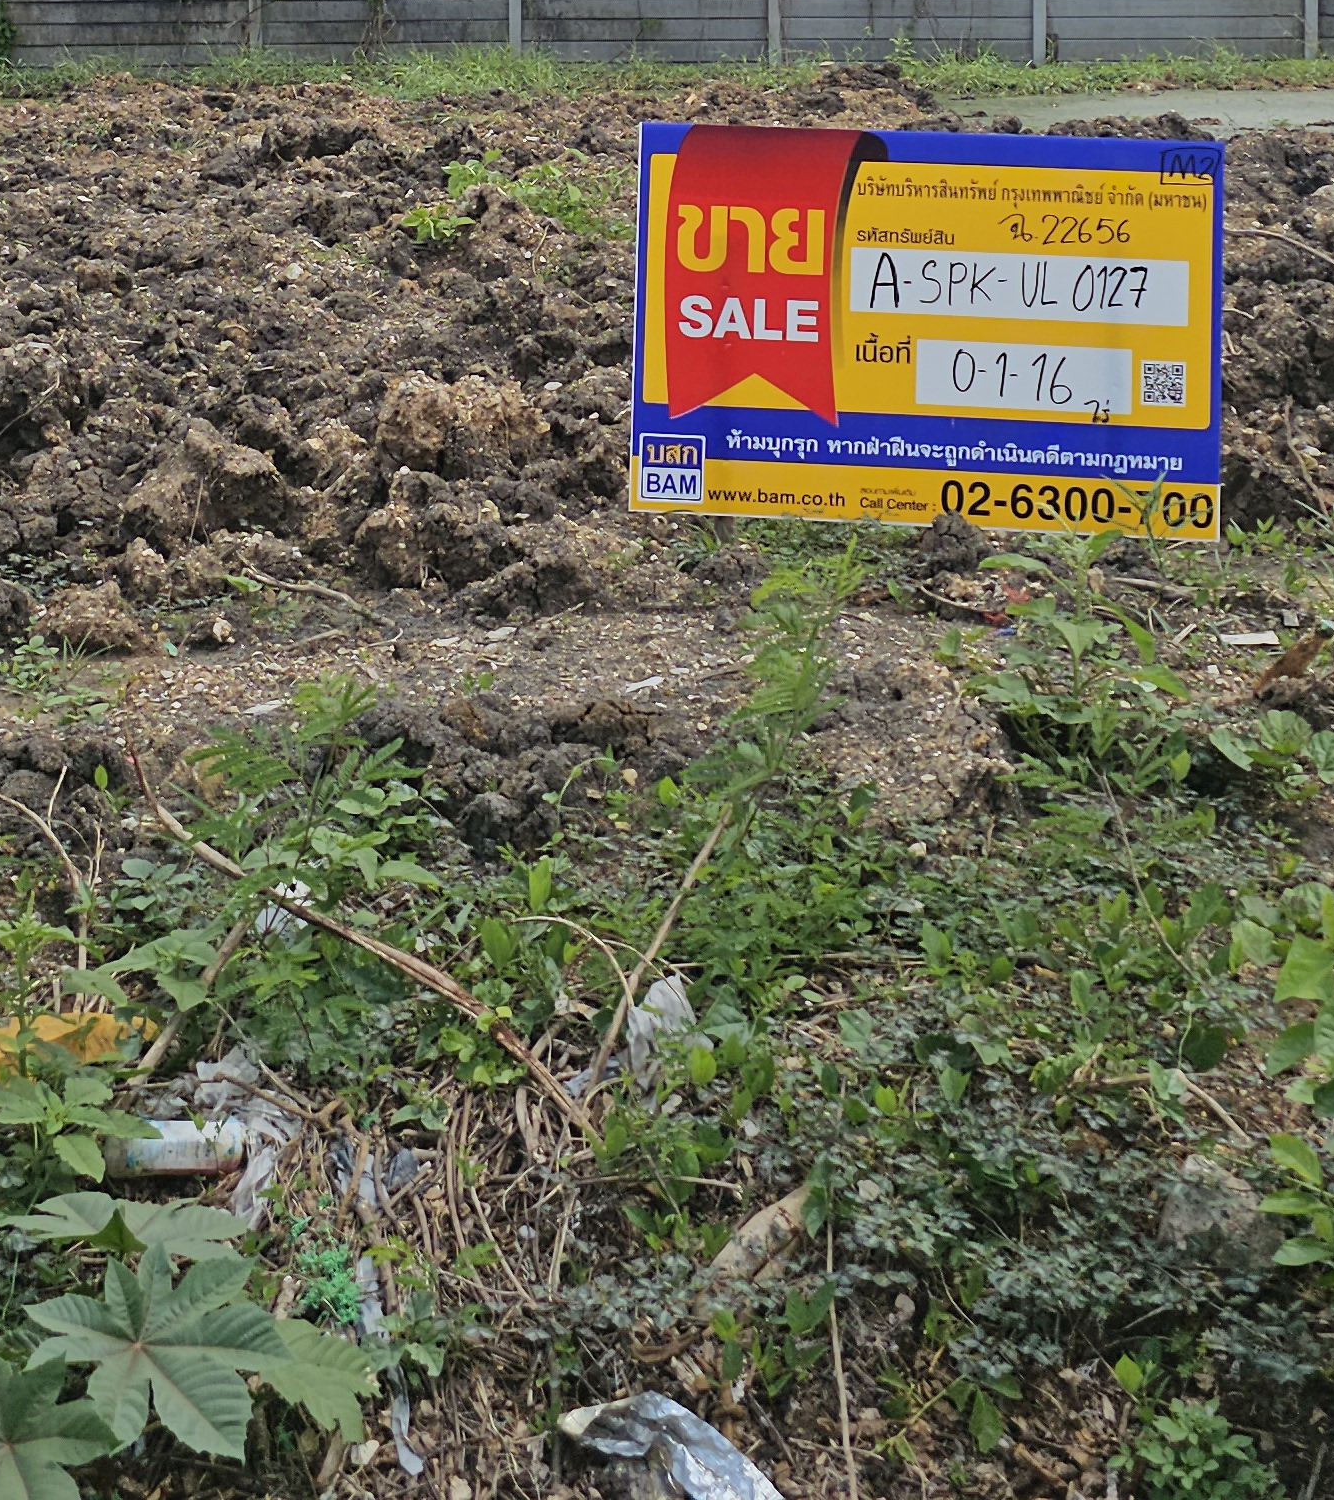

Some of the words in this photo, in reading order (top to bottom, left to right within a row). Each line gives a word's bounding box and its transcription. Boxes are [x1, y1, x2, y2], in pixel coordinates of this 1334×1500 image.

[1168, 152, 1215, 181] M2
[857, 175, 999, 201] บริษัทบริหารสินทรัพย์
[1001, 183, 1105, 209] กรุงเทพพาณิชย์
[1108, 185, 1144, 207] จำกัด
[1148, 190, 1207, 212] (มหาชน)
[677, 202, 824, 276] ขาย
[856, 227, 955, 246] รหัสทรัพย์สิน
[678, 294, 820, 343] SALE
[855, 333, 912, 365] เนื้อที่
[646, 441, 698, 465] บสก
[726, 428, 818, 459] ห้ามบุกรุก
[827, 436, 1183, 474] หากฝ่าฝืนจะถูกดำเนินคดีตามกฎหมาย
[647, 473, 697, 495] BAM
[708, 488, 845, 507] www.bam.co.th
[860, 497, 883, 508] Call
[887, 498, 929, 511] Center
